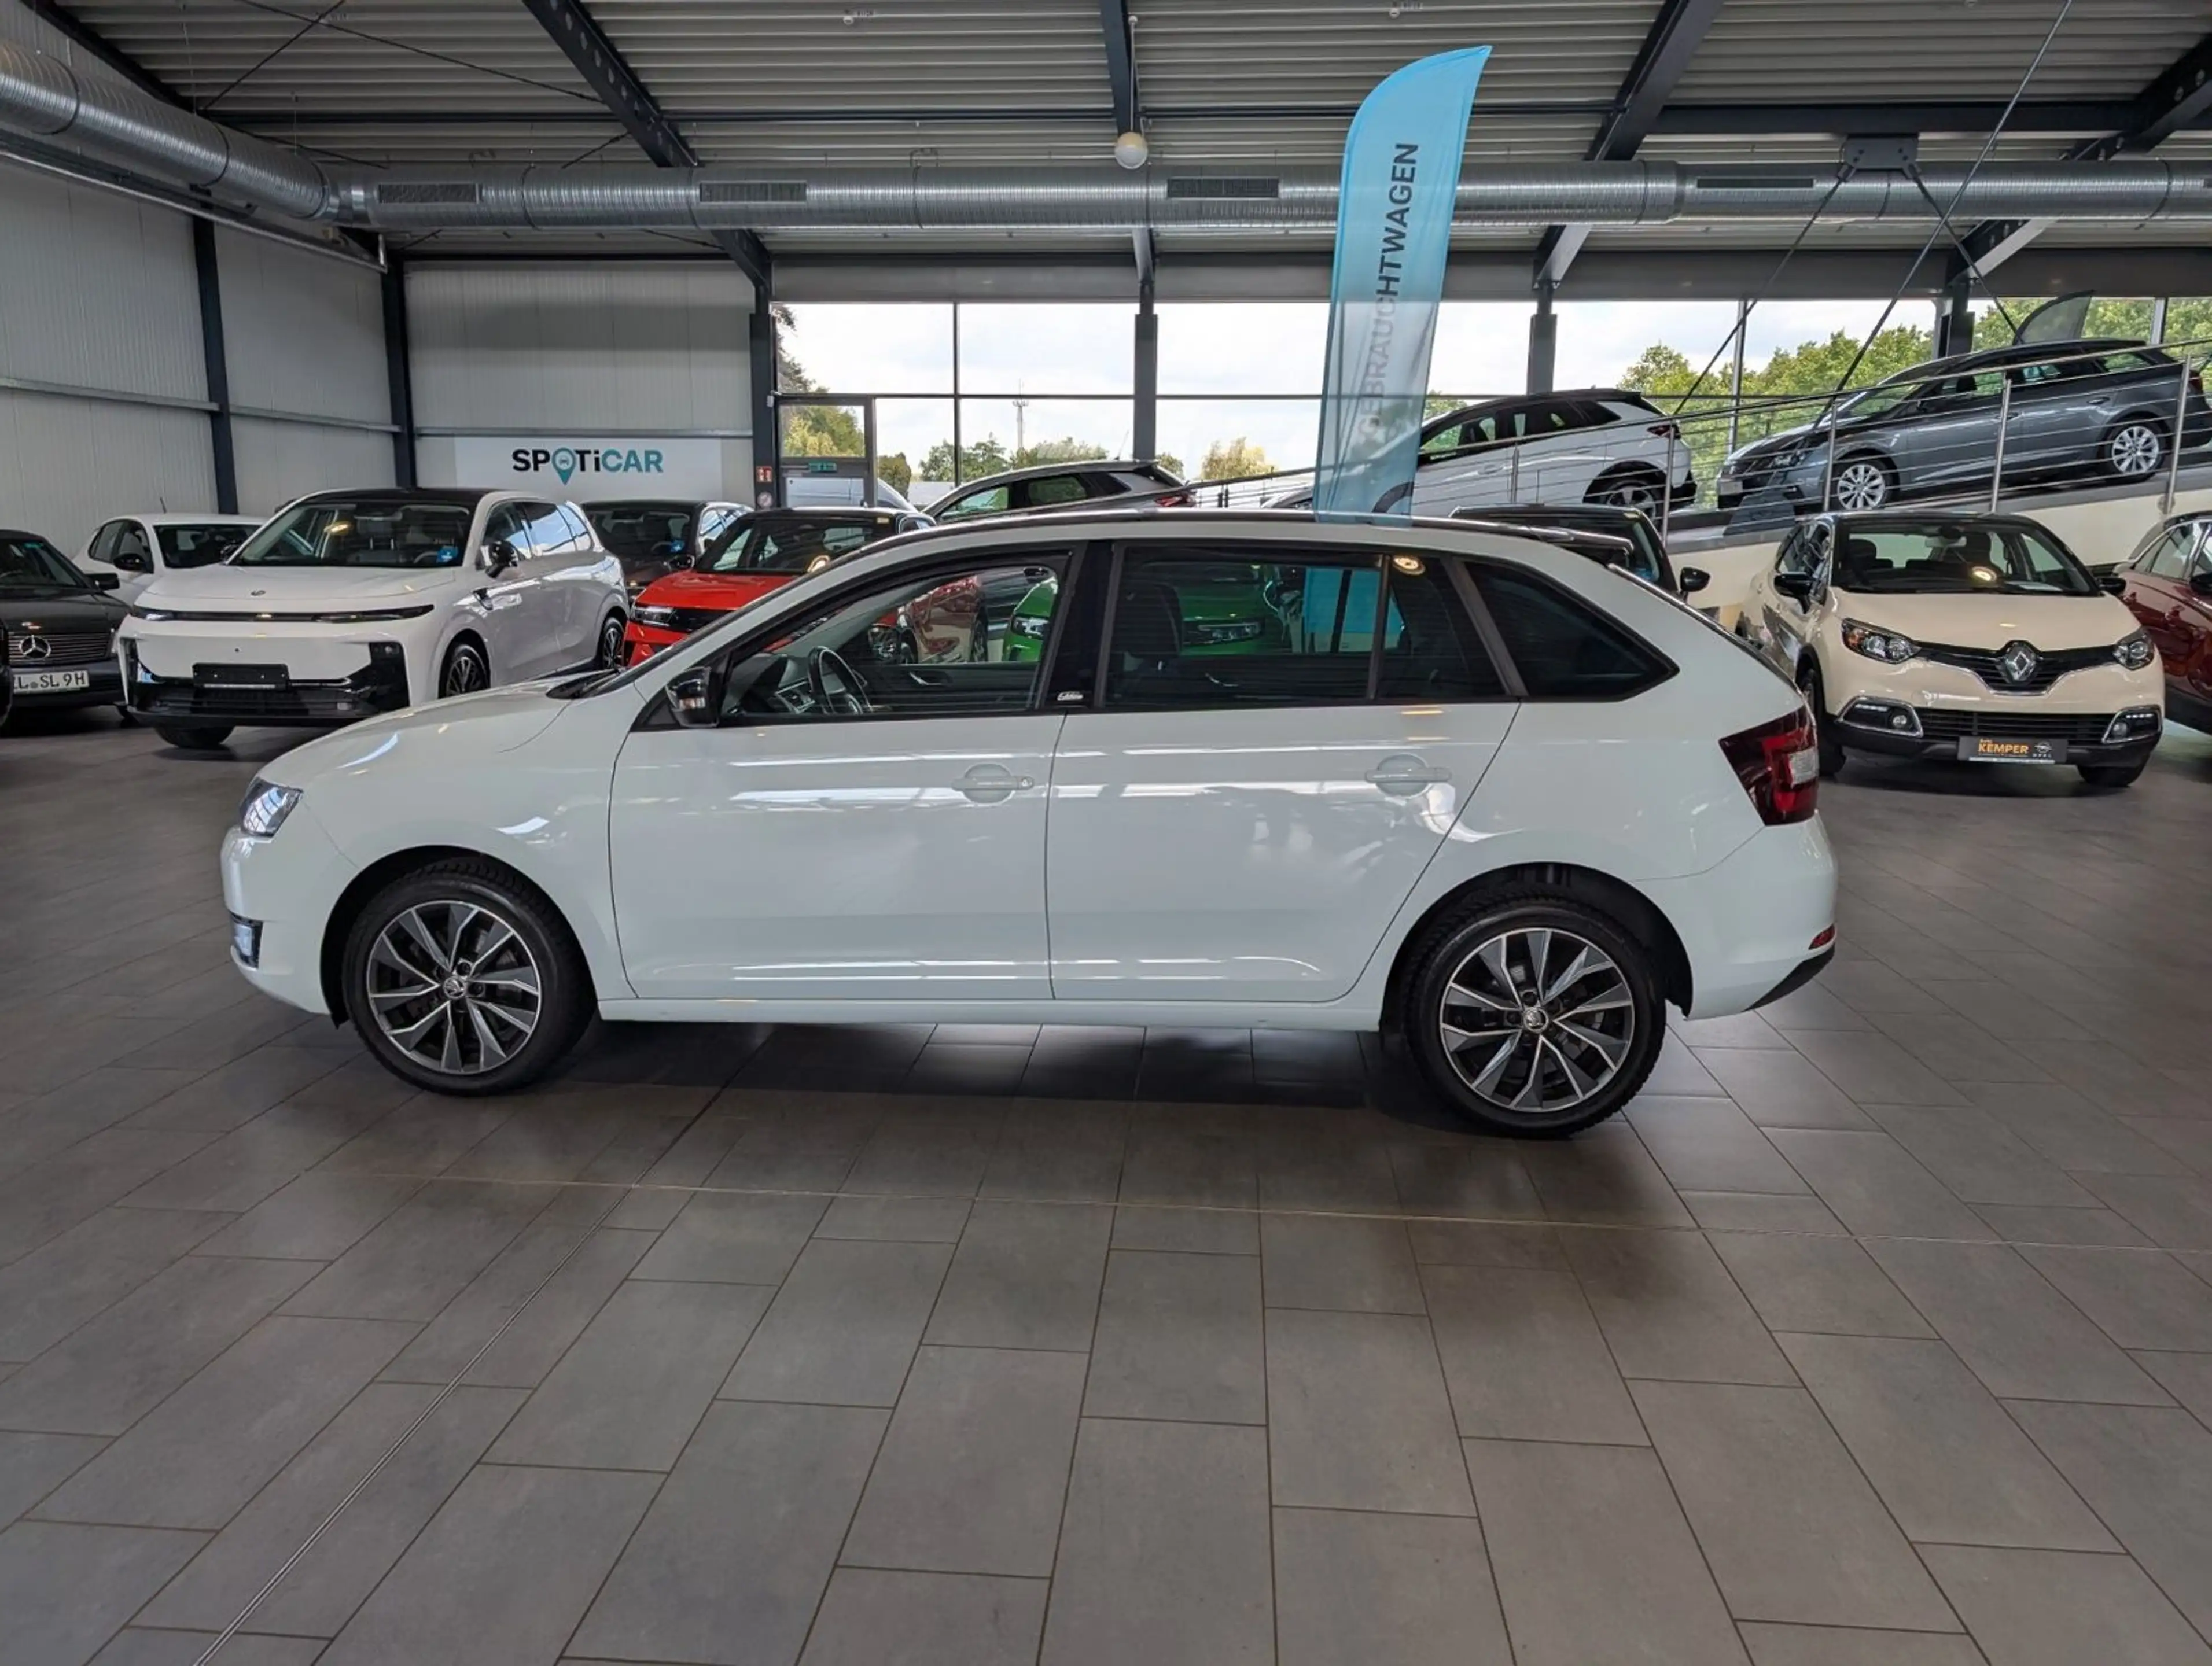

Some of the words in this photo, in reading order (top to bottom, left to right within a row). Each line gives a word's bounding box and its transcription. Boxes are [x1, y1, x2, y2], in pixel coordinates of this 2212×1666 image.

[1358, 143, 1419, 437] GEBRAUCHTWAGEN
[39, 674, 59, 688] SL
[1978, 743, 2029, 754] KEMPER
